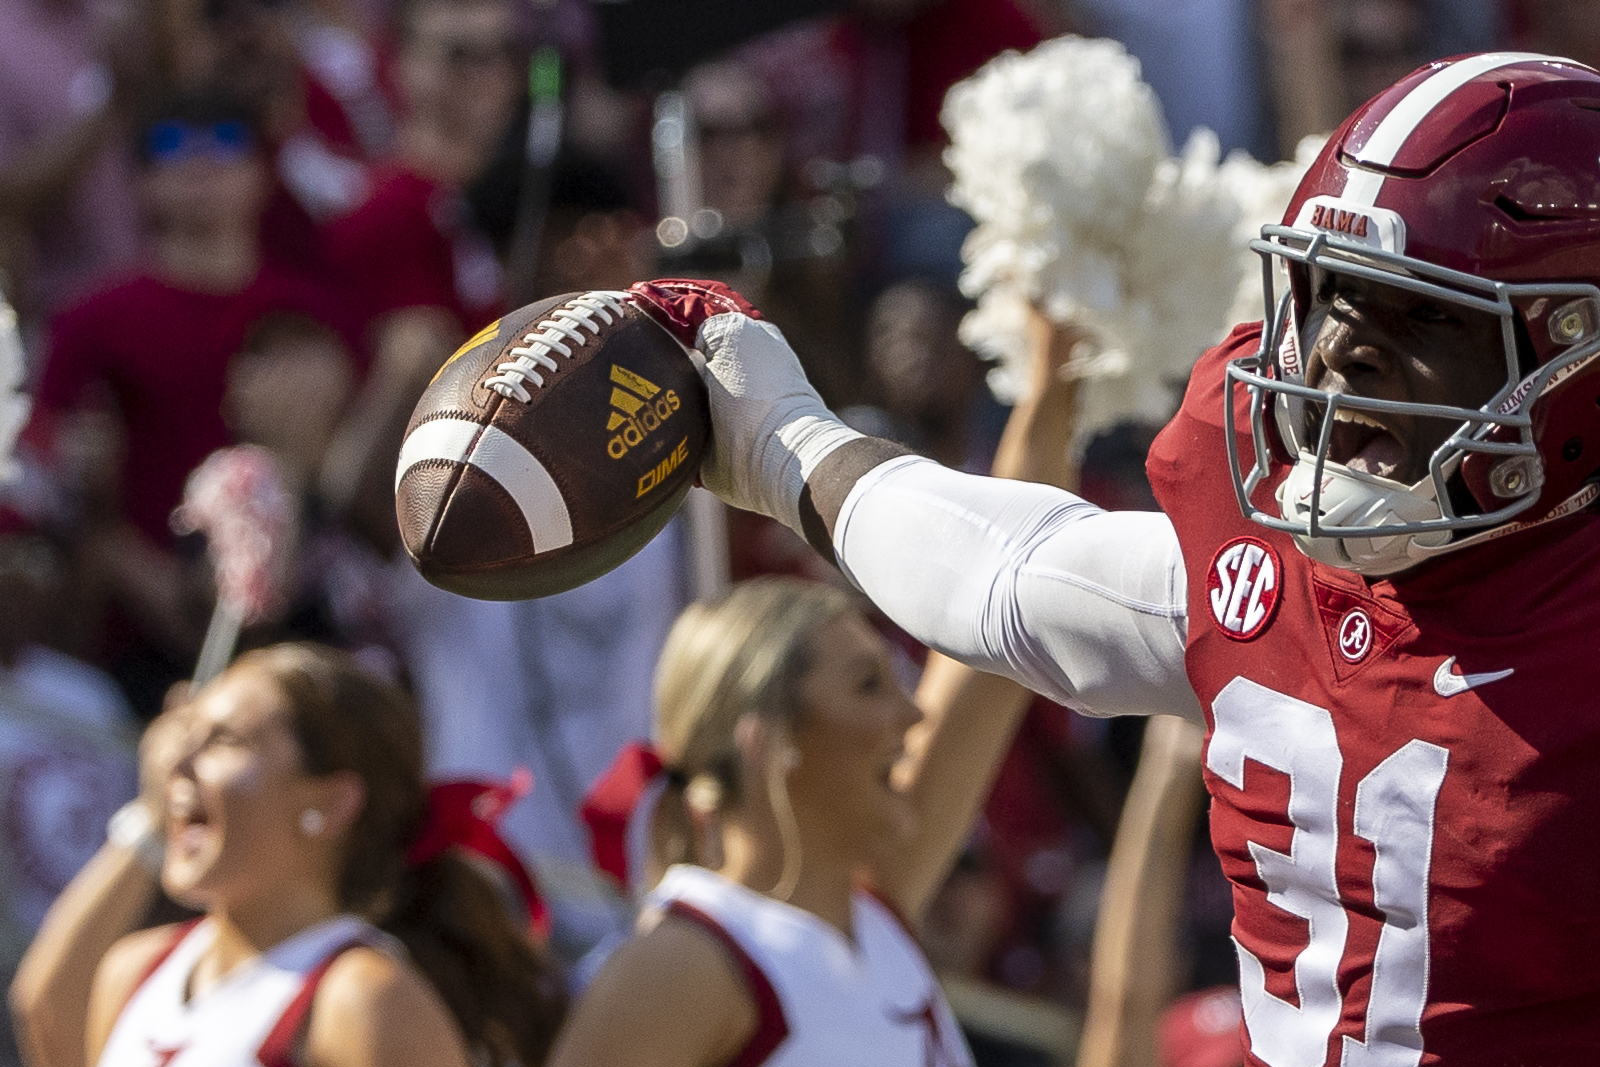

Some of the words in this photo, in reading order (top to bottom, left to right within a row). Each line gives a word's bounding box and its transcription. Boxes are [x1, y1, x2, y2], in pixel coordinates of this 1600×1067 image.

[1310, 204, 1369, 238] BAMA
[607, 389, 681, 459] adidas
[636, 436, 689, 498] DIME
[1210, 543, 1275, 634] SEC
